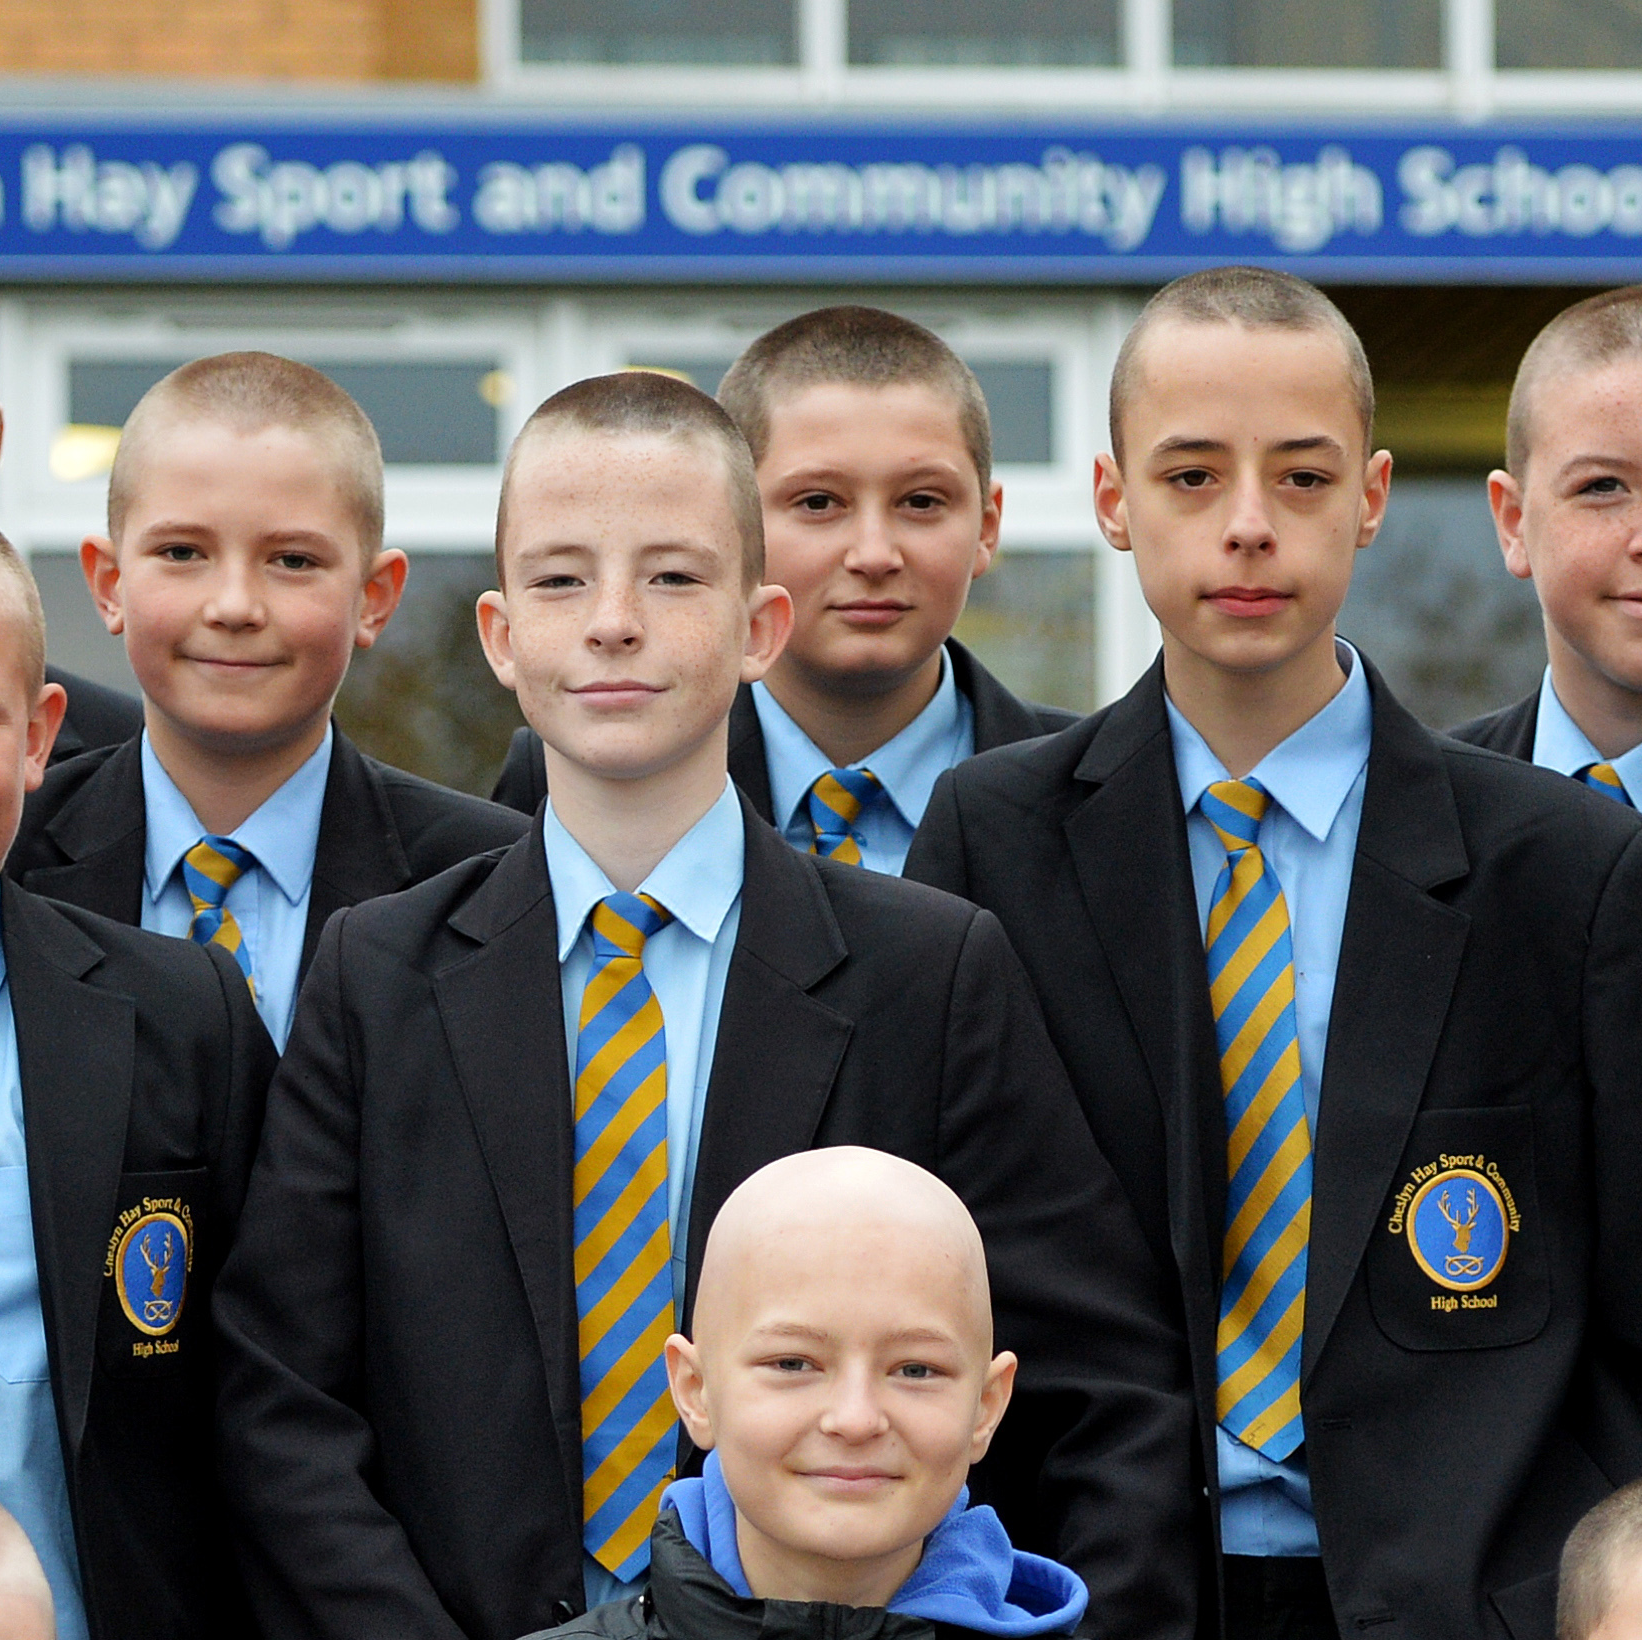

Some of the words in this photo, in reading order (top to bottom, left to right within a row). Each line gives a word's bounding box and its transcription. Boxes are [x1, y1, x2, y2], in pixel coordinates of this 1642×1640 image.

[20, 142, 199, 252] Hay
[210, 141, 461, 252] Sport
[471, 142, 648, 236] and
[661, 142, 1168, 253] Community
[1181, 144, 1384, 254] High
[1388, 1182, 1415, 1234] Cheslyn
[1410, 1161, 1438, 1183] Hay
[1439, 1153, 1475, 1169] Sport
[1475, 1154, 1485, 1170] &
[1486, 1162, 1522, 1233] Community
[119, 1205, 142, 1228] Hay
[142, 1196, 173, 1212] Sport
[1430, 1295, 1458, 1313] High
[1461, 1294, 1498, 1309] School
[132, 1343, 154, 1358] High
